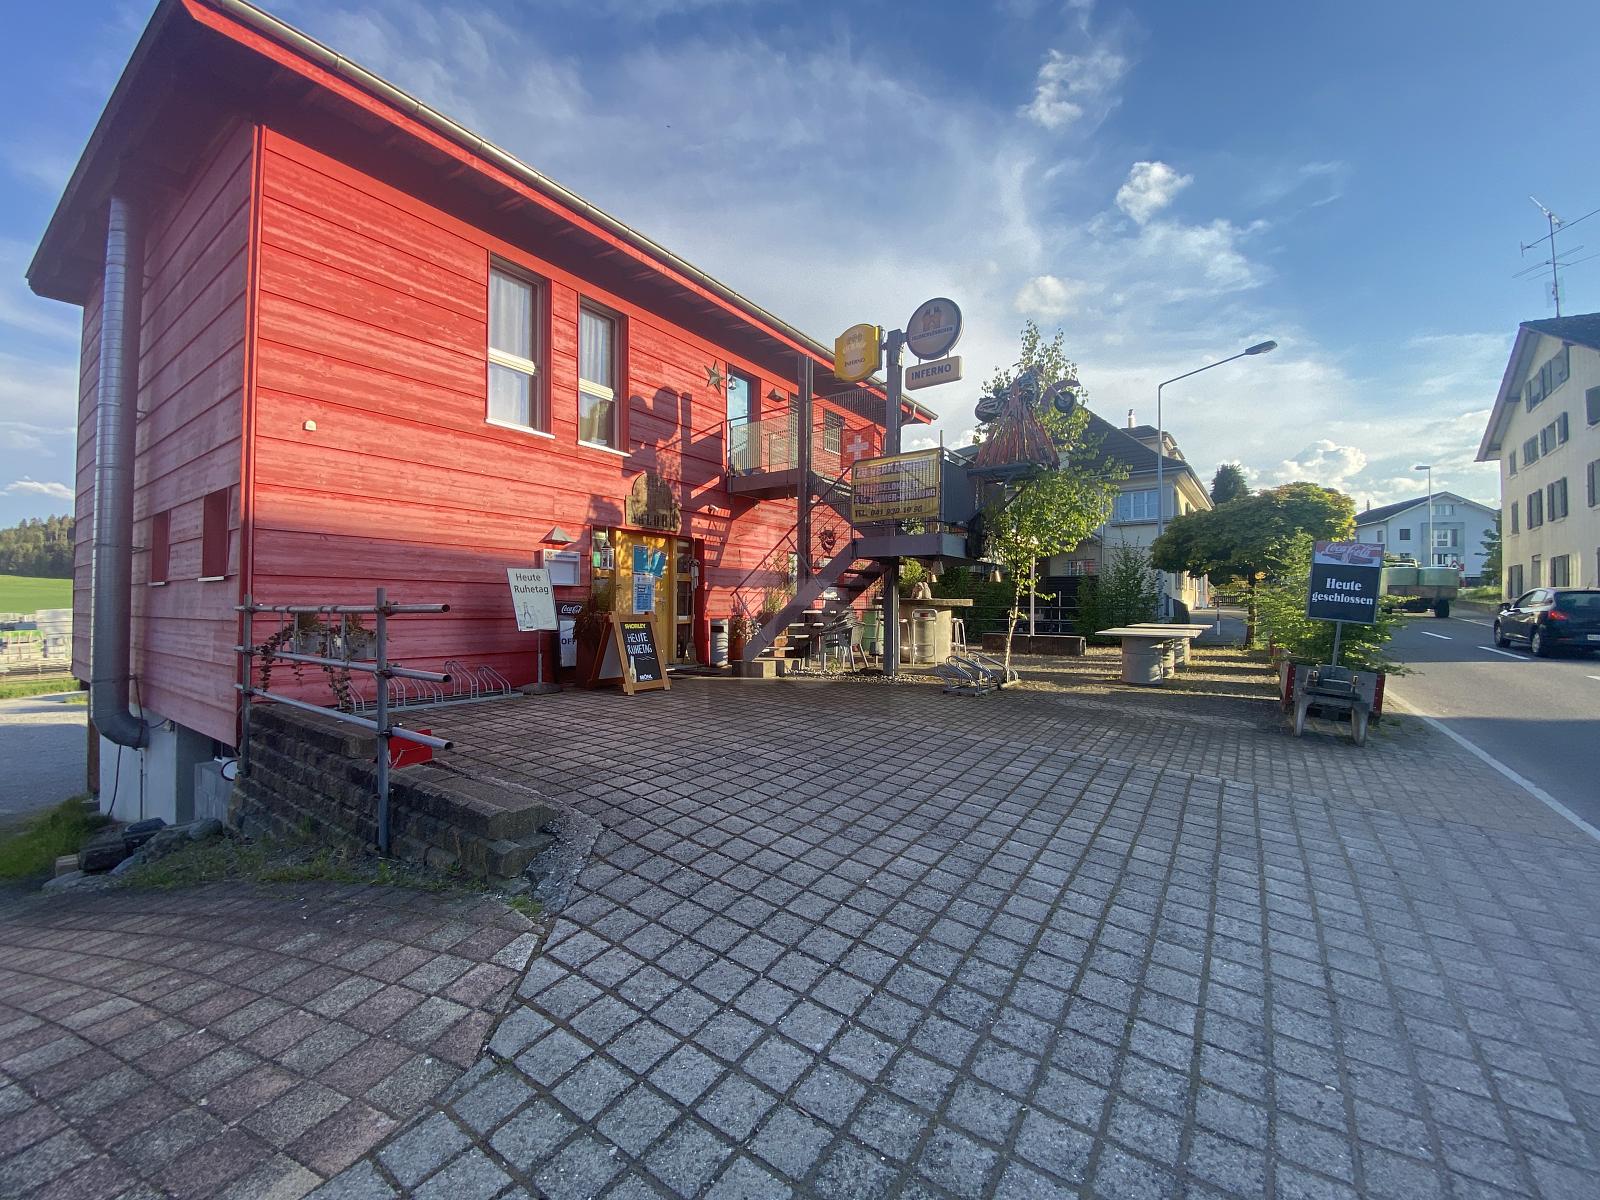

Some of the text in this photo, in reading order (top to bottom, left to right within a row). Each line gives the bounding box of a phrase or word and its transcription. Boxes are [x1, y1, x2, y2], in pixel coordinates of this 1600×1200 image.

[911, 363, 952, 381] INFERNO
[515, 573, 542, 582] Heute
[513, 585, 549, 595] Ruhetag
[1325, 577, 1362, 591] Heute
[1311, 591, 1374, 605] geschlossen
[627, 632, 649, 643] HEUTE
